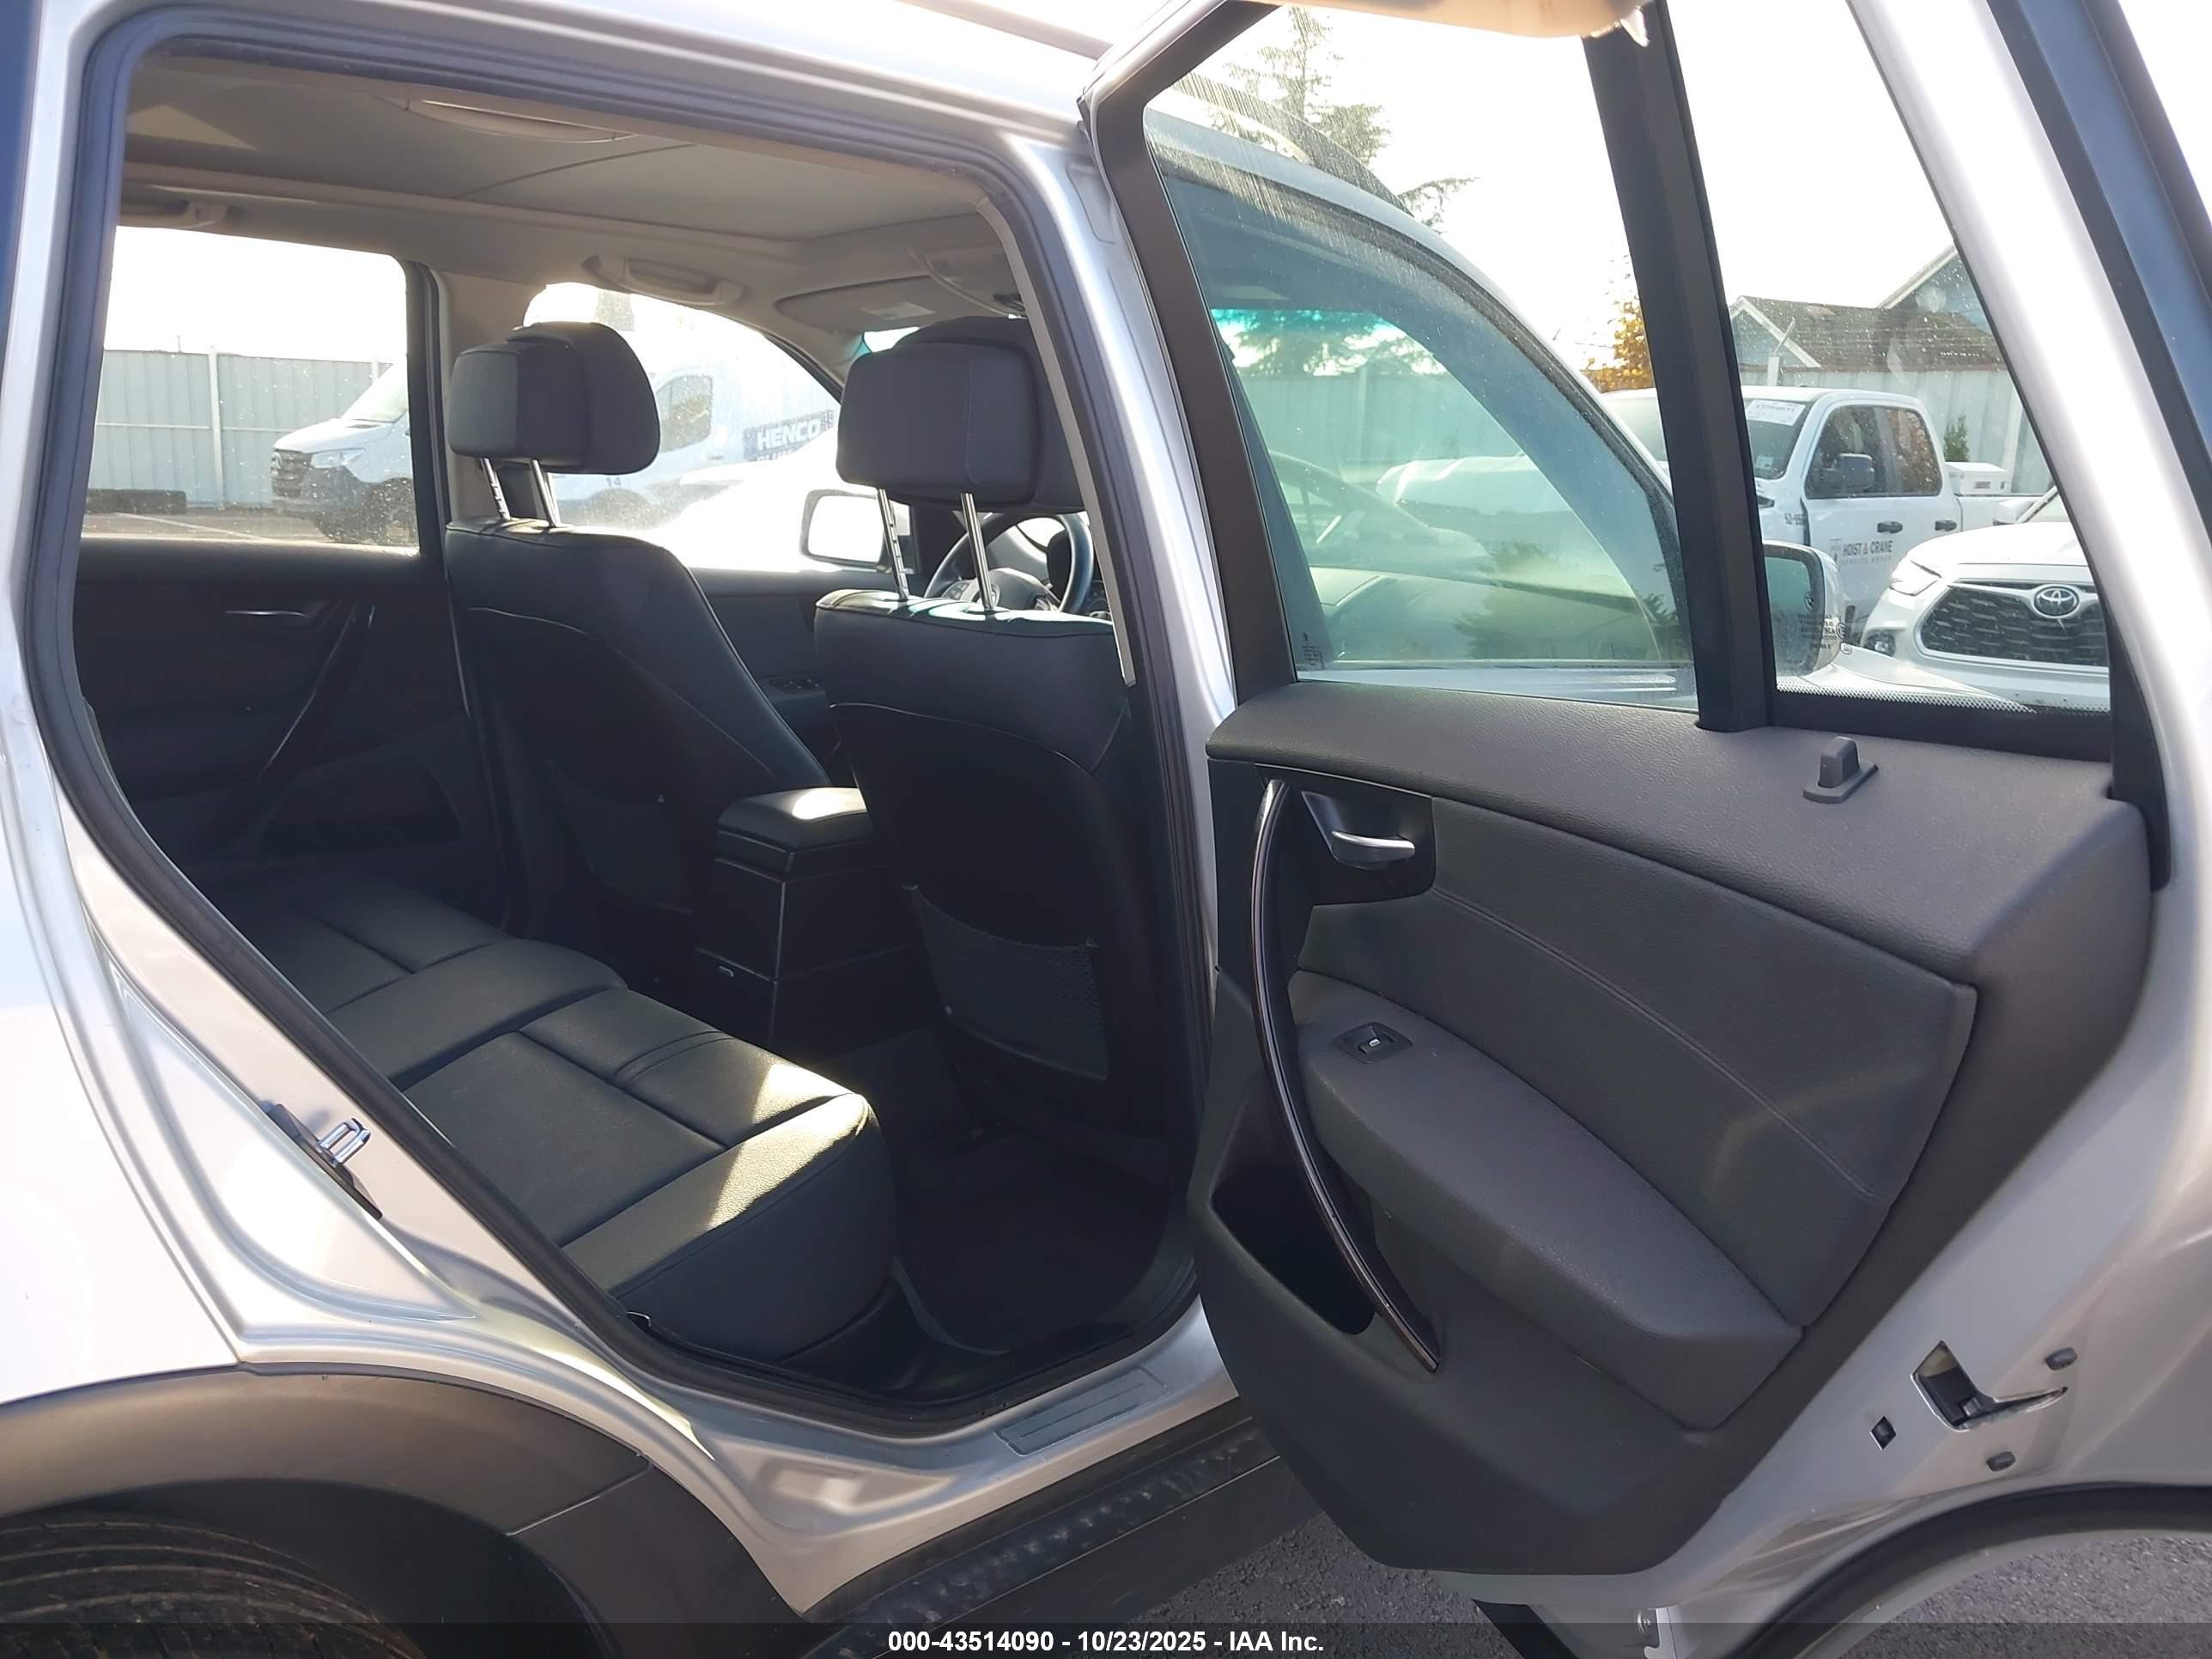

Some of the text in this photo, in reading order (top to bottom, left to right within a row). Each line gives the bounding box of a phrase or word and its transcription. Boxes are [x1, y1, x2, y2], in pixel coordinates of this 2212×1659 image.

[756, 417, 822, 451] HENCO
[605, 476, 622, 488] 14
[1842, 542, 1863, 556] HOIST
[1869, 540, 1893, 556] CRANE
